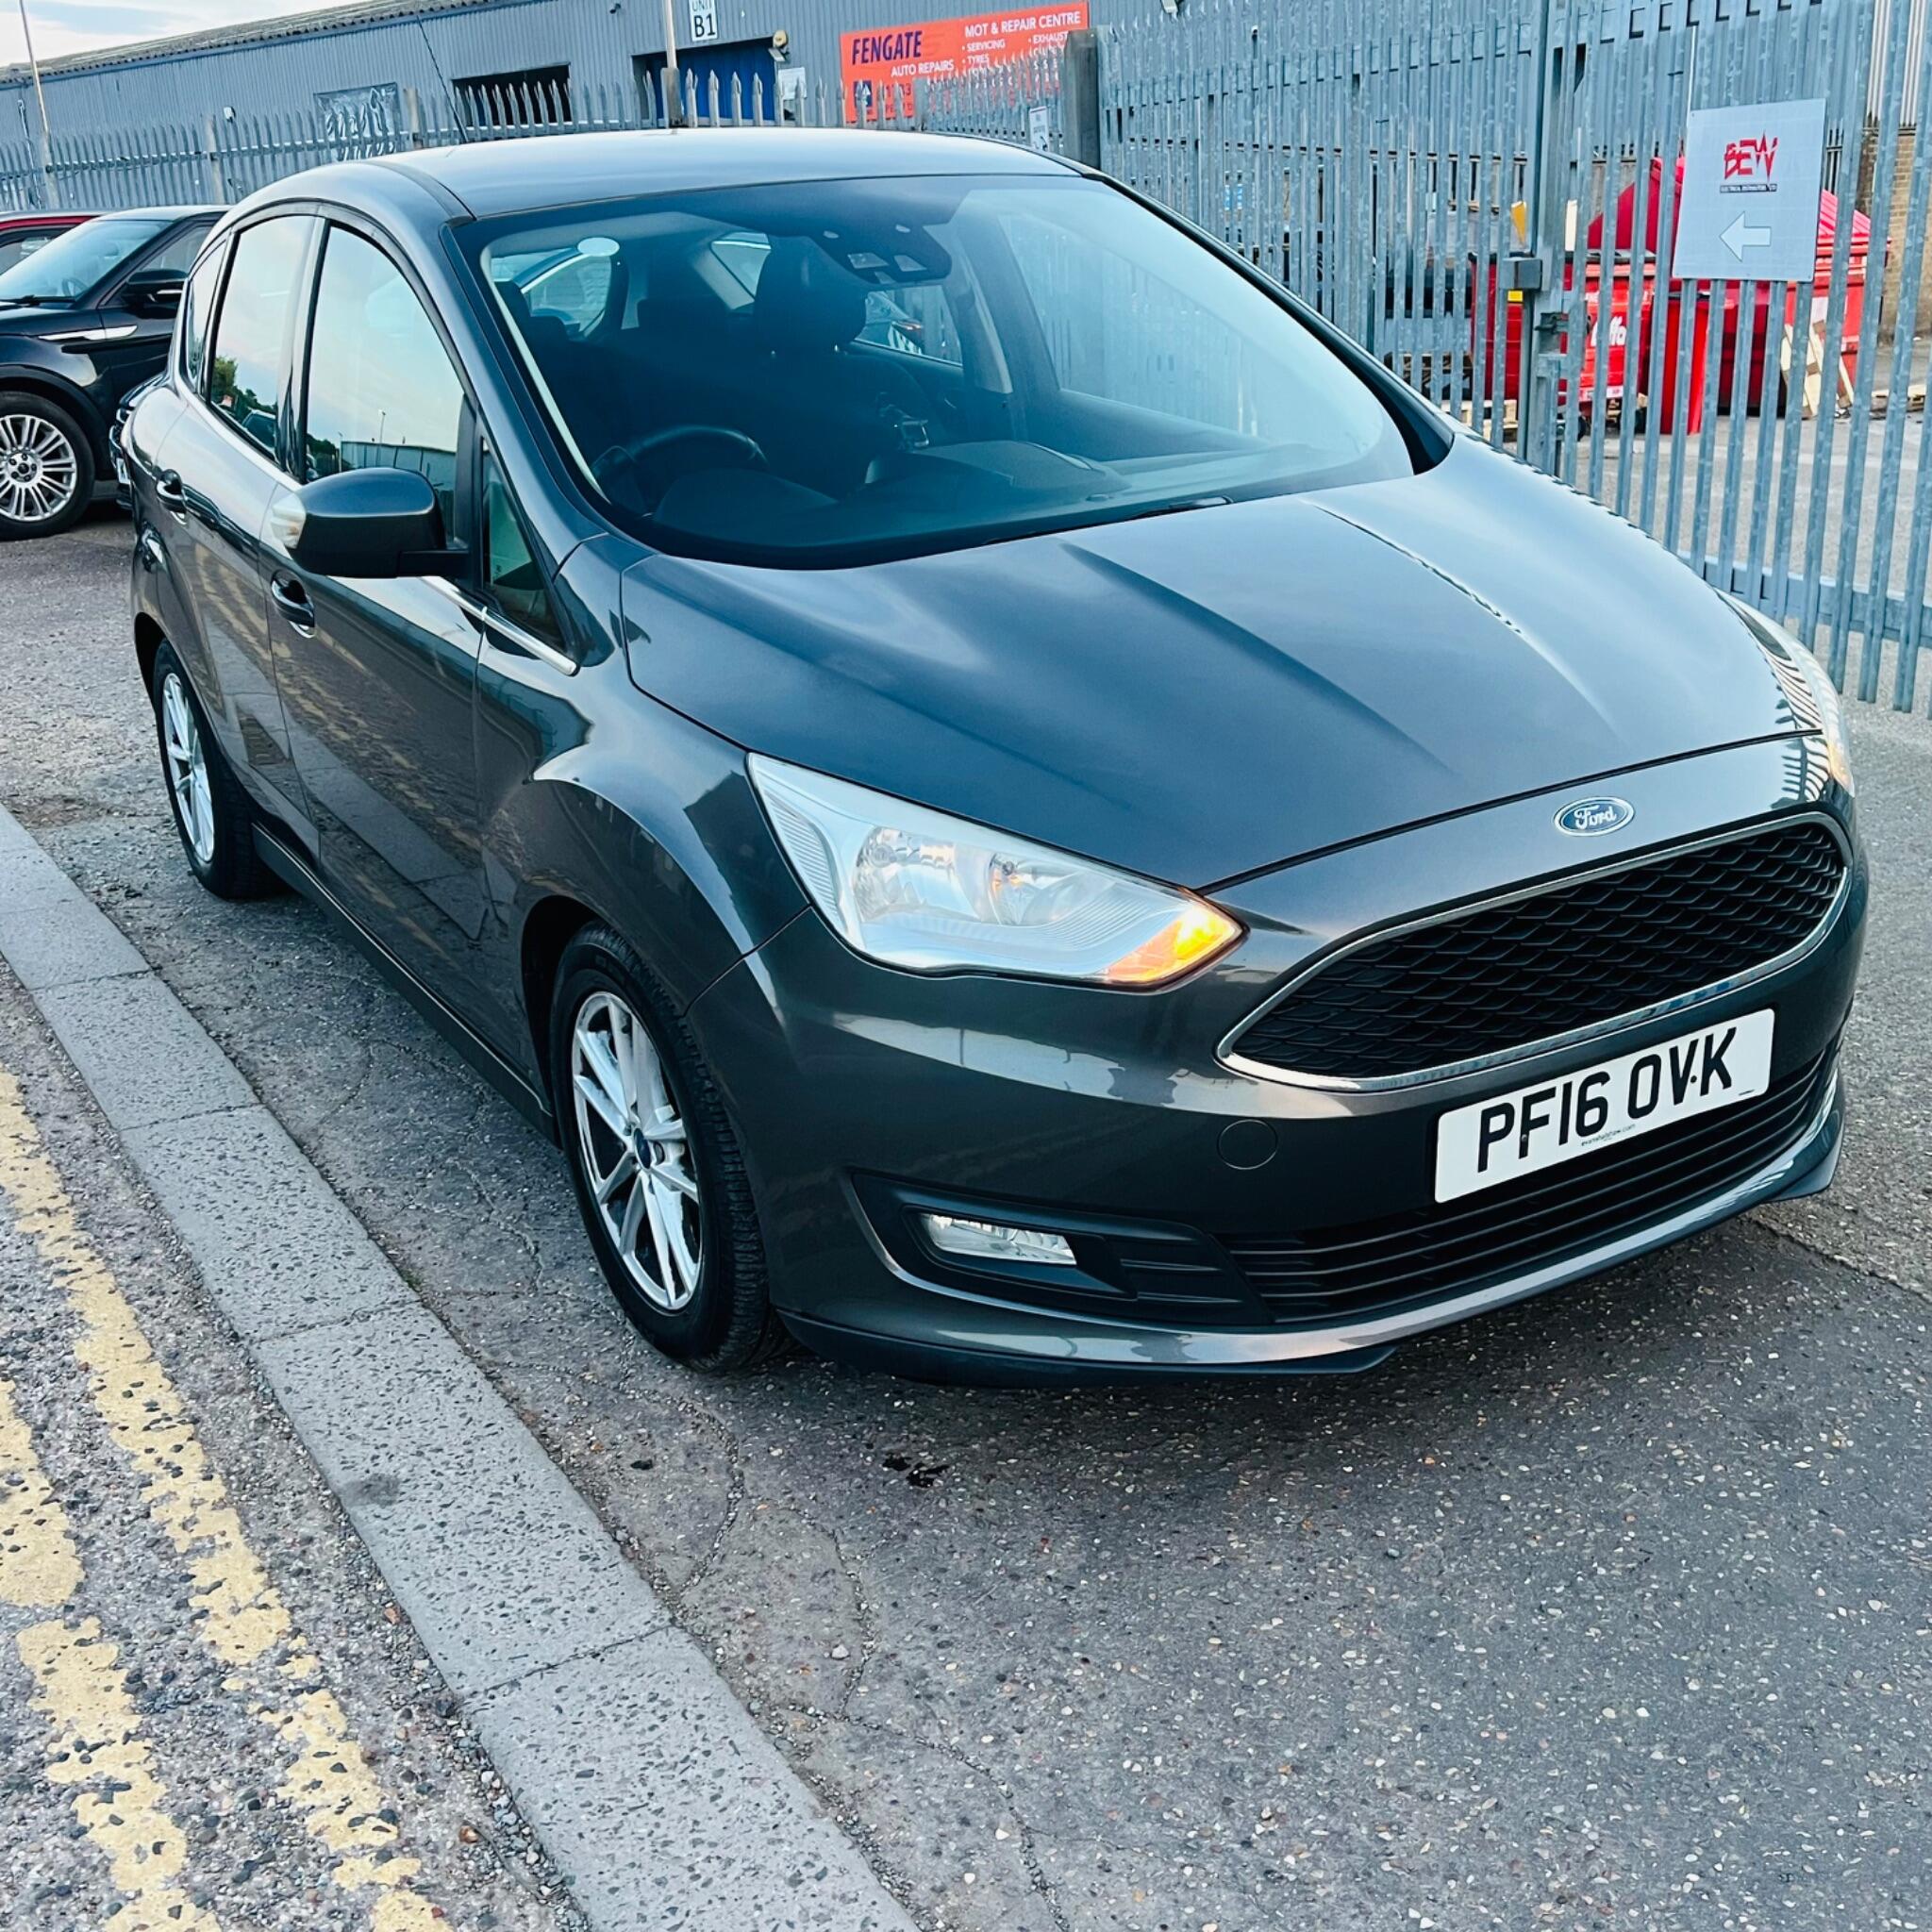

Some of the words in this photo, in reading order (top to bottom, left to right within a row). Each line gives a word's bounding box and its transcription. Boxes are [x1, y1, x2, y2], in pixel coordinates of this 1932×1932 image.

[693, 13, 715, 38] B1
[965, 23, 989, 38] MOT
[991, 22, 999, 35] &
[1001, 17, 1036, 33] REPAIR
[1039, 11, 1081, 28] CENTRE
[852, 30, 923, 65] FENGATE
[891, 63, 917, 77] AUTO
[918, 58, 955, 74] REPAIRS
[1574, 805, 1617, 830] Ford
[1626, 1026, 1738, 1121] OVK
